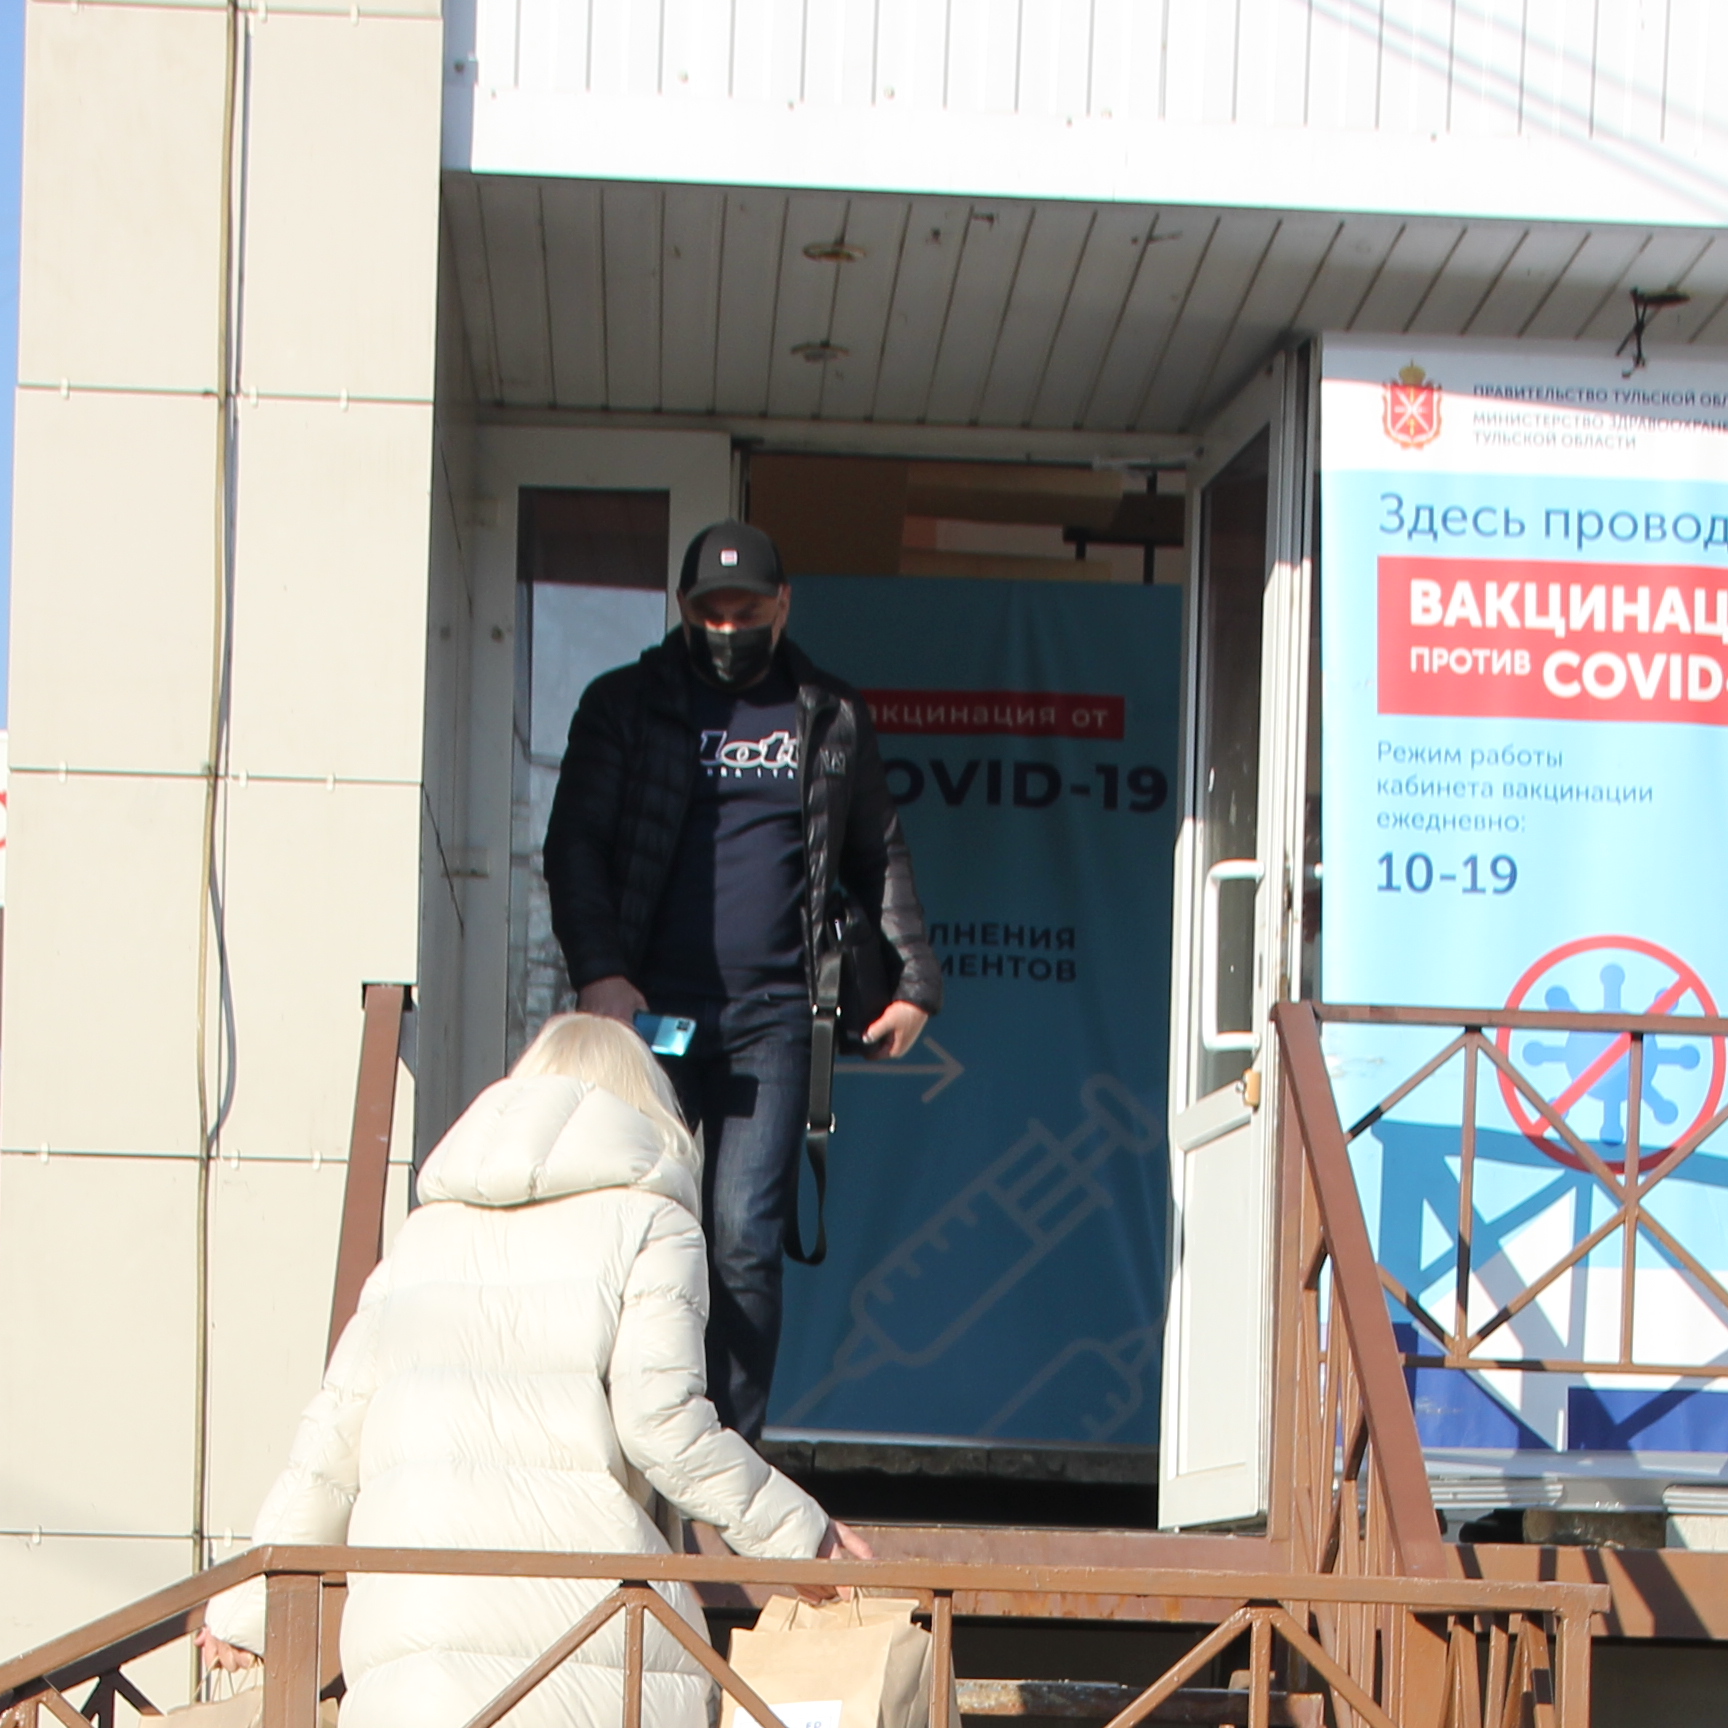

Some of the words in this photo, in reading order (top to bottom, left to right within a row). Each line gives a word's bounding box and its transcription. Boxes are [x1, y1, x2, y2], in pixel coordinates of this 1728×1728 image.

[1473, 384, 1607, 402] ПРАВИТЕЛЬСТВО
[1613, 387, 1695, 406] ТУЛЬСКОЙ
[1473, 410, 1604, 430] МИНИСТЕРСТВО
[1475, 429, 1556, 446] ТУЛЬСКОЙ
[1561, 431, 1636, 449] ОБЛАСТИ
[1379, 492, 1526, 541] Здесь
[1410, 647, 1531, 676] ПРОТИВ
[1072, 708, 1108, 729] от
[1377, 740, 1462, 765] Режим
[1471, 743, 1563, 770] работы
[883, 757, 1168, 813] OVID-19
[1377, 774, 1493, 798] кабинета
[1503, 780, 1653, 804] вакцинации
[1377, 810, 1526, 832] ежедневно:
[1377, 851, 1518, 895] 10-19
[927, 921, 1076, 950] ЛНЕНИЯ
